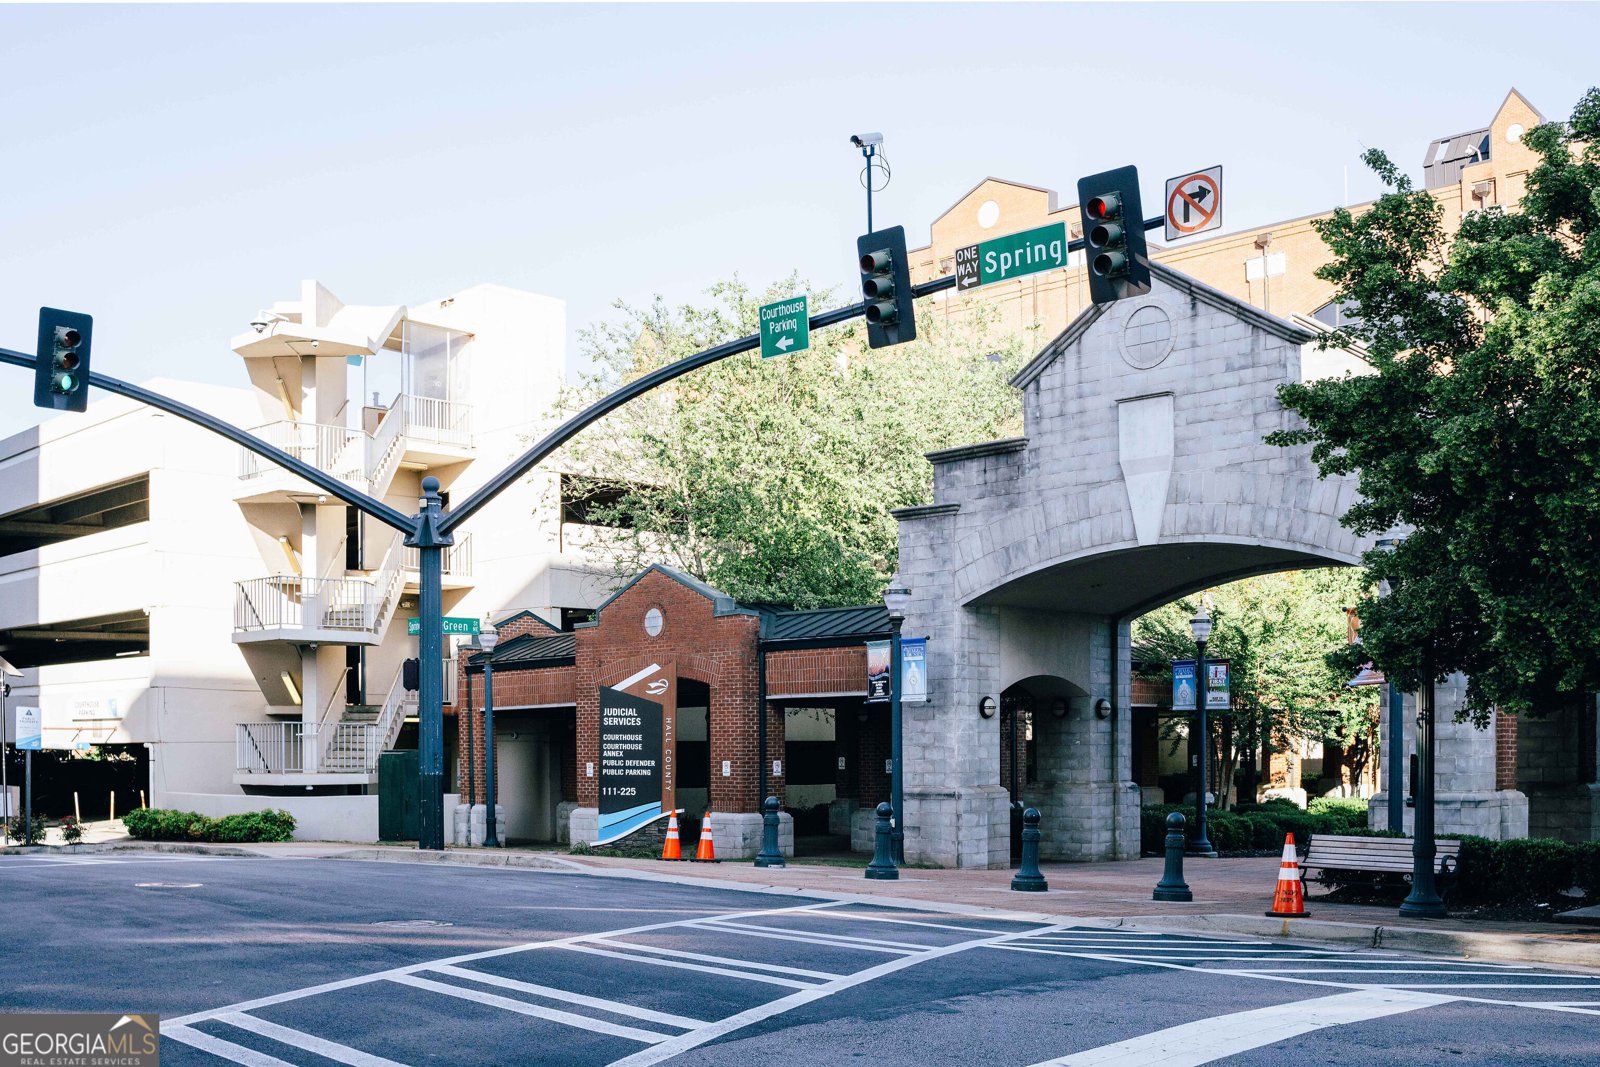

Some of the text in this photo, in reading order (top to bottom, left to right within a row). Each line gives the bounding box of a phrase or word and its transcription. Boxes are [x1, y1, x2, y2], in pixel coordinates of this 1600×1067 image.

[957, 246, 978, 262] ONE
[985, 240, 1062, 278] Spring
[957, 260, 979, 276] WAY
[761, 301, 804, 320] Courthouse
[769, 318, 797, 334] Parking
[443, 620, 468, 631] Green
[603, 707, 638, 716] JUDICIAL
[603, 717, 642, 726] SERVICES
[602, 787, 637, 796] 111-225
